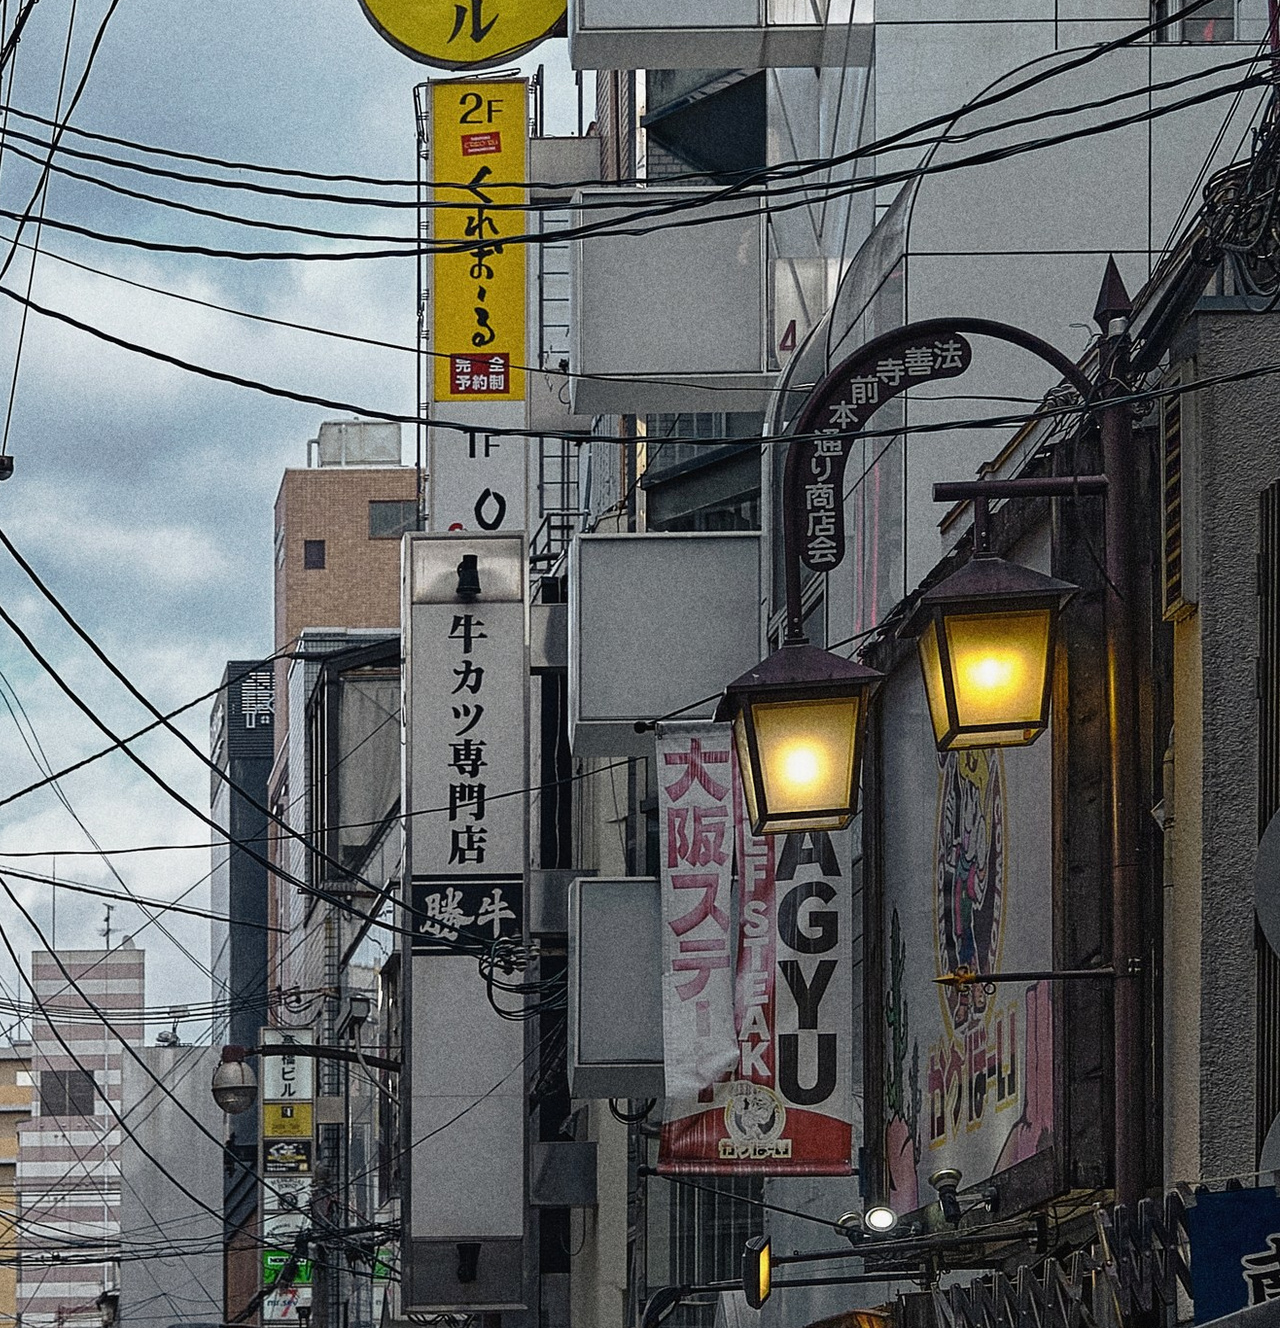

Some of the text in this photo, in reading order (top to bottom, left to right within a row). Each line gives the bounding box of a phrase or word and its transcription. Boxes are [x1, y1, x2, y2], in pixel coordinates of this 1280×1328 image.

[459, 92, 504, 124] 2F
[455, 356, 505, 372] 完全
[455, 374, 505, 391] 予約制
[779, 320, 798, 352] 4
[804, 340, 964, 565] 法善寺前本通り商店会
[447, 613, 489, 865] 牛カツ専門店
[663, 737, 731, 1103] 大阪ステー
[738, 900, 771, 1076] STEAK
